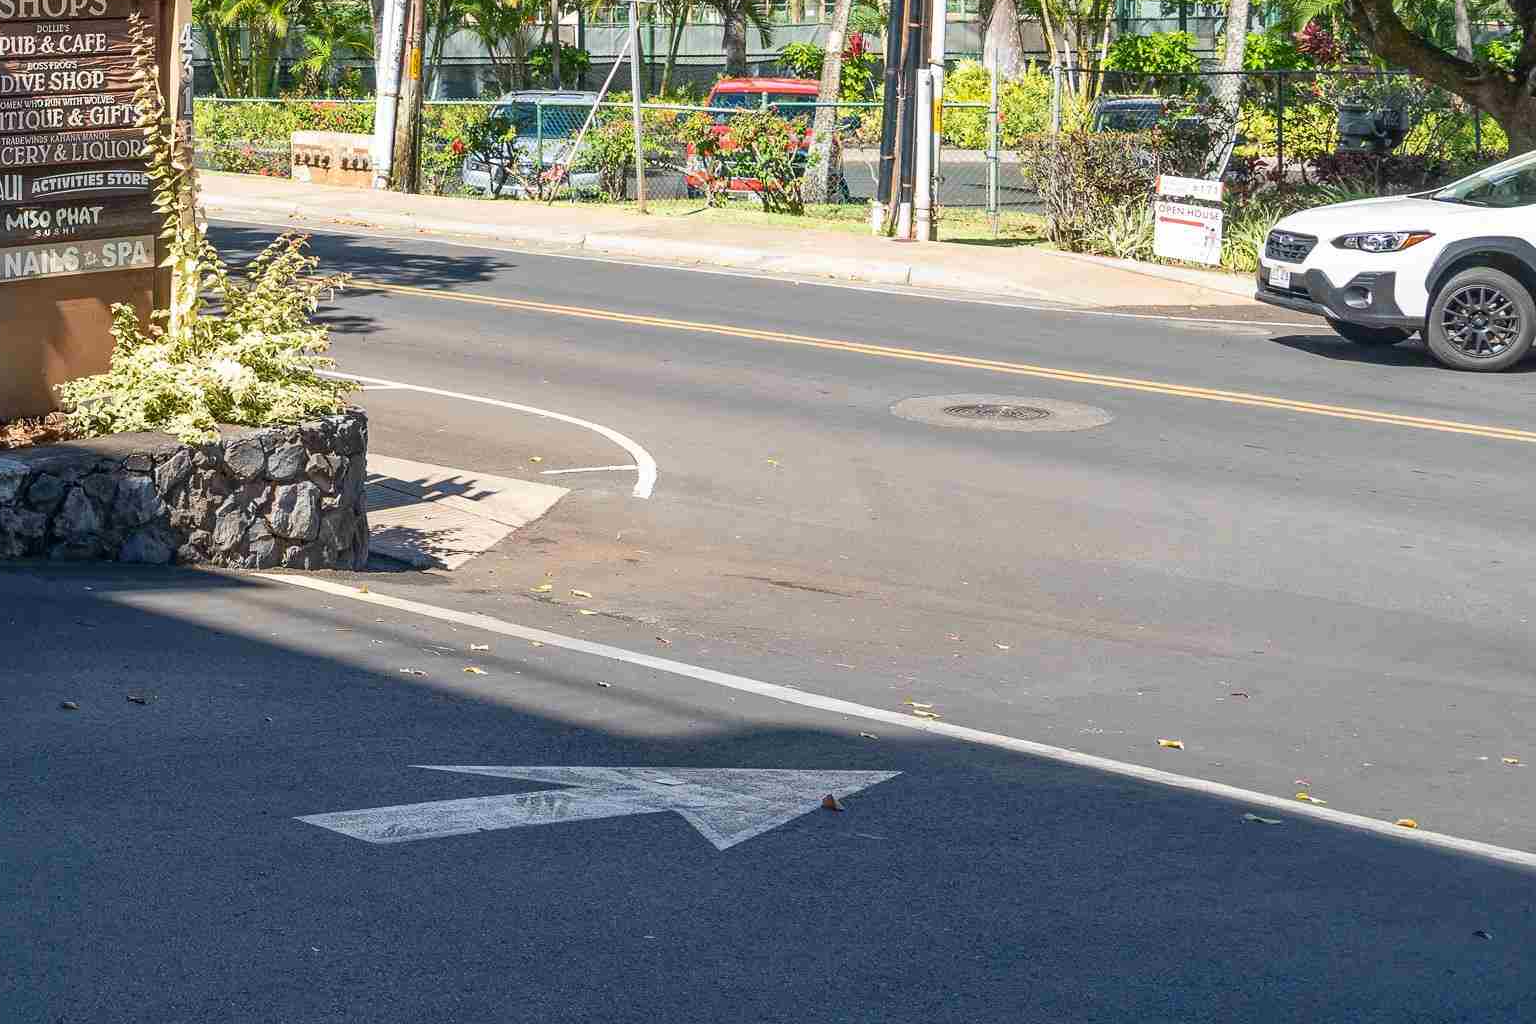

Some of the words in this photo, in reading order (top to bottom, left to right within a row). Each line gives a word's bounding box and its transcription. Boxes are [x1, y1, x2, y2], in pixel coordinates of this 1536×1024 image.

[36, 24, 71, 33] DOLLIE'S
[40, 35, 55, 54] &
[59, 33, 106, 53] CAFE
[0, 73, 46, 94] DIVE
[49, 70, 104, 91] SHOP
[24, 100, 46, 109] WHO
[46, 97, 61, 107] RUN
[63, 97, 82, 106] WITH
[84, 95, 115, 105] WOLVES
[68, 108, 84, 127] &
[90, 104, 142, 126] GIFTS
[1, 135, 48, 146] TRADEWINDS
[51, 133, 81, 144] KAHANA
[82, 132, 111, 142] MANOR
[54, 143, 68, 162] &
[72, 138, 149, 161] LIQUORS
[31, 174, 104, 194] ACTIVITIES
[107, 173, 149, 186] STORE
[5, 210, 52, 232] MISO
[55, 206, 104, 227] PHAT
[1158, 204, 1185, 215] OPEN
[1187, 208, 1221, 221] HOUSE
[33, 227, 75, 238] SUSHI
[4, 246, 80, 278] NAILS
[102, 240, 145, 267] SPA
